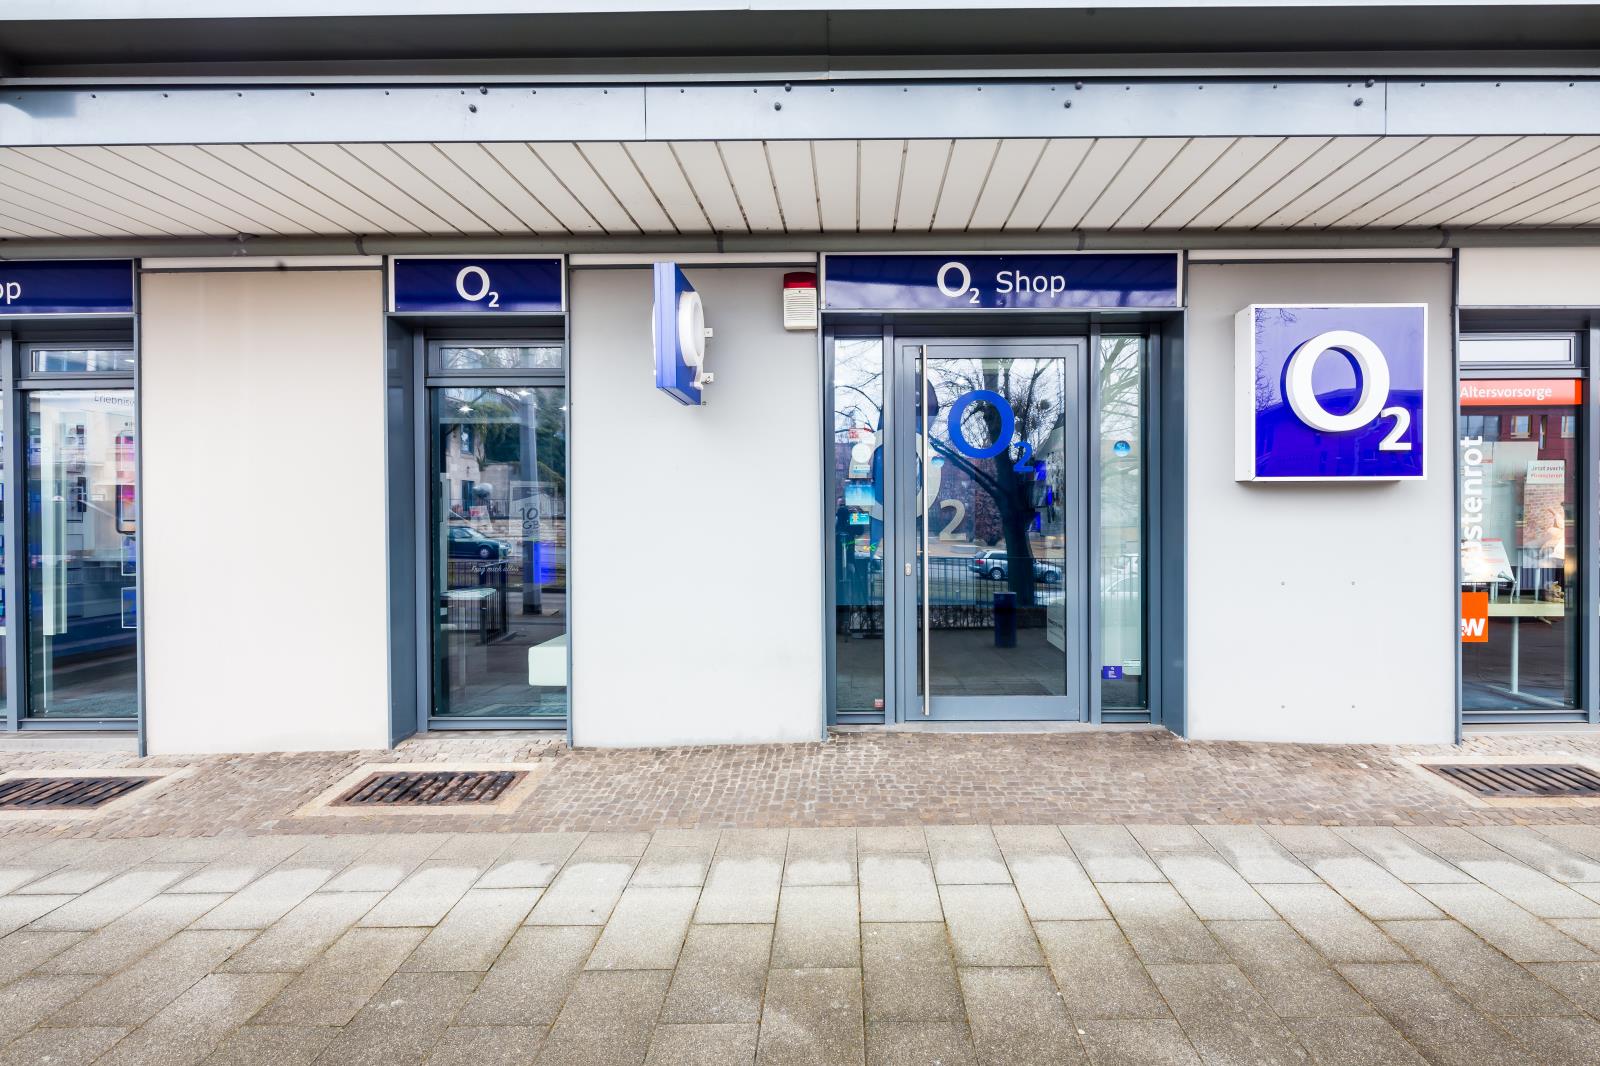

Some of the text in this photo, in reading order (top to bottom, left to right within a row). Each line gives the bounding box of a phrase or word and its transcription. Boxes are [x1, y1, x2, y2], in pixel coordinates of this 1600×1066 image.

[0, 281, 22, 305] p
[456, 265, 500, 308] O2
[936, 261, 1066, 304] O2 Shop
[1286, 330, 1412, 451] O2
[1459, 385, 1553, 401] Altersvorsorge
[947, 389, 1034, 473] O2
